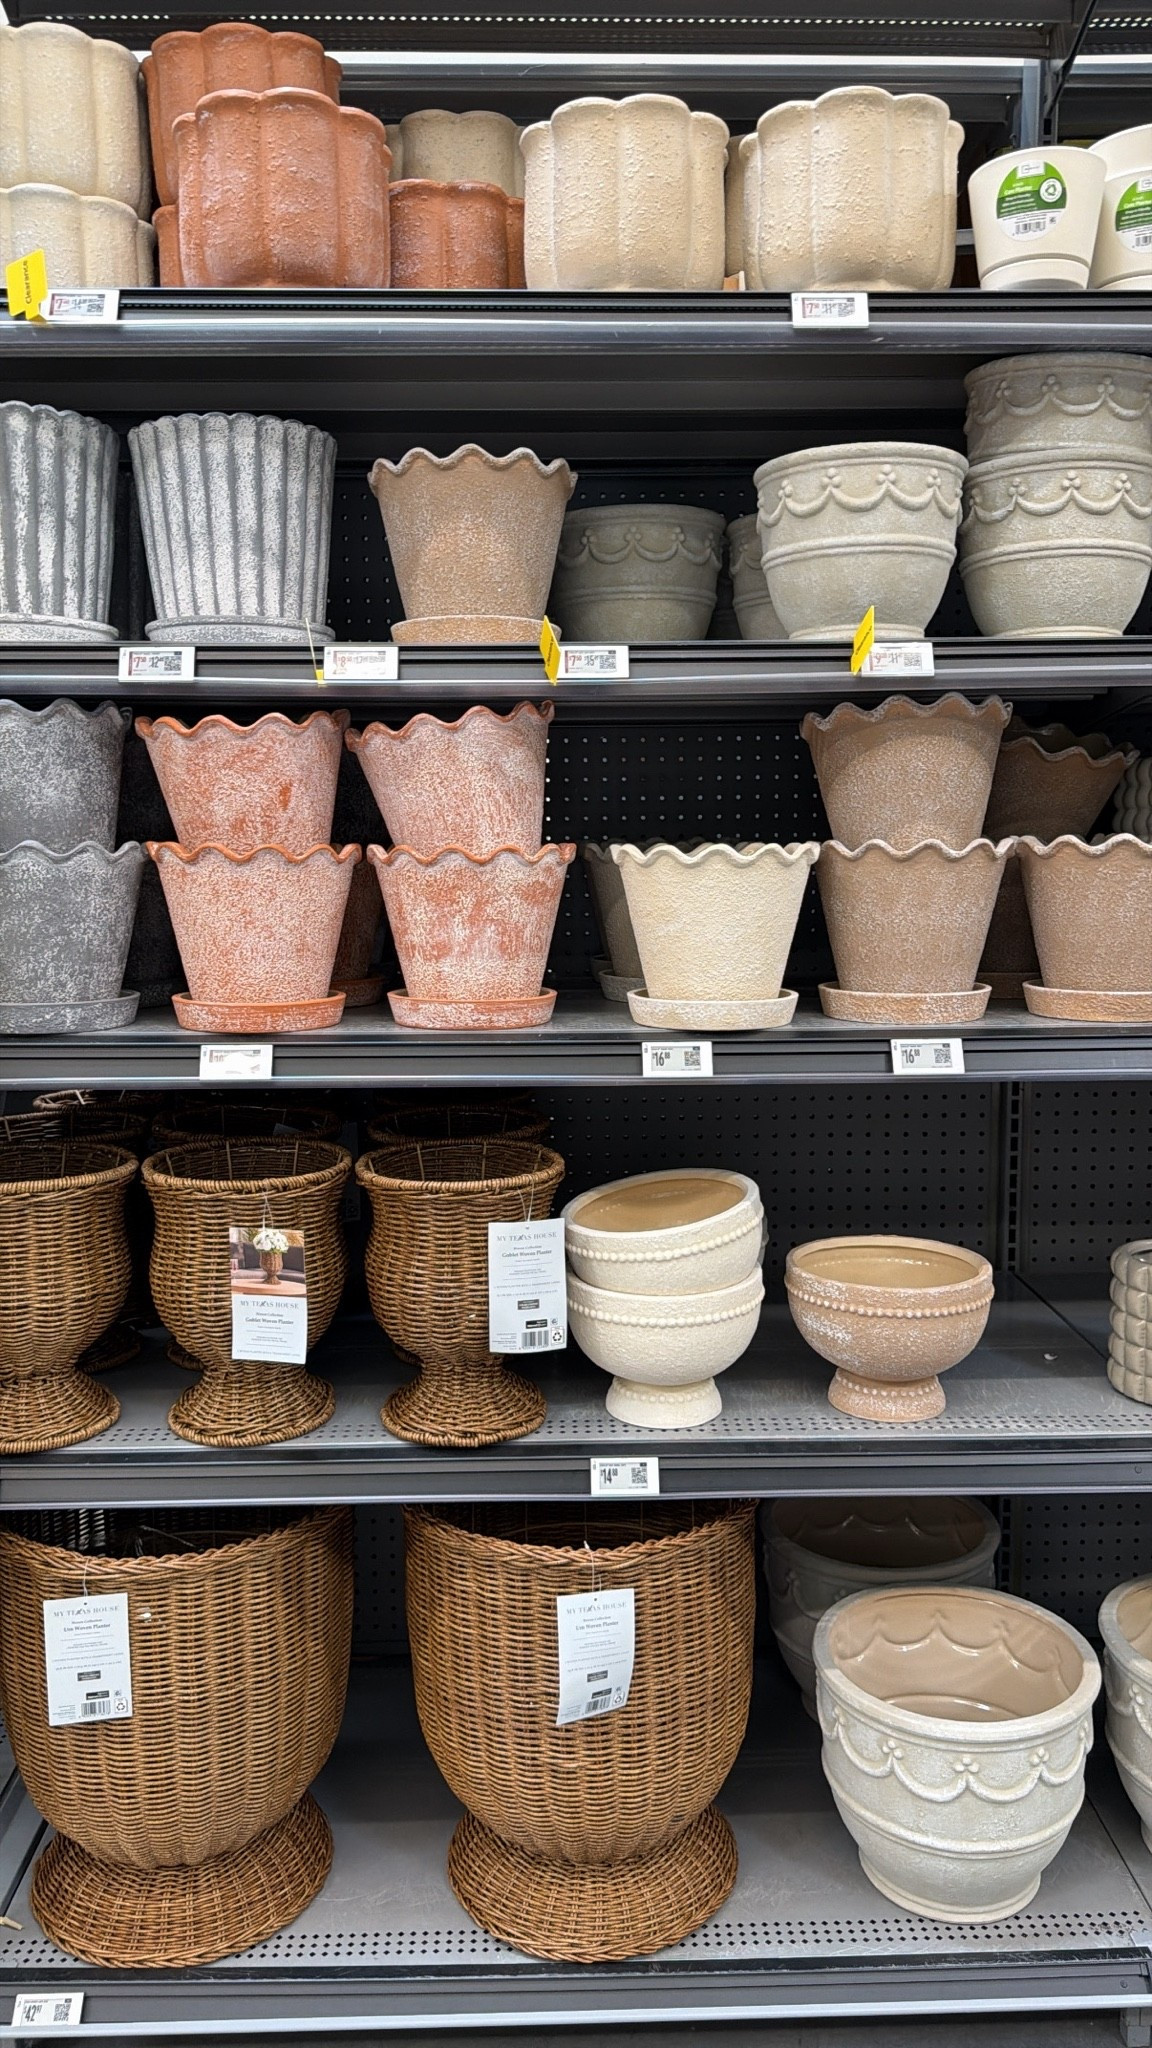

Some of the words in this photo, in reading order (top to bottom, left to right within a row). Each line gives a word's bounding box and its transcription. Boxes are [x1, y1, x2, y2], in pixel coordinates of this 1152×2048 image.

[22, 260, 32, 304] Clearance
[93, 1605, 119, 1614] HOUSE
[579, 1605, 601, 1613] TEXAS
[603, 1602, 627, 1610] HOUSE
